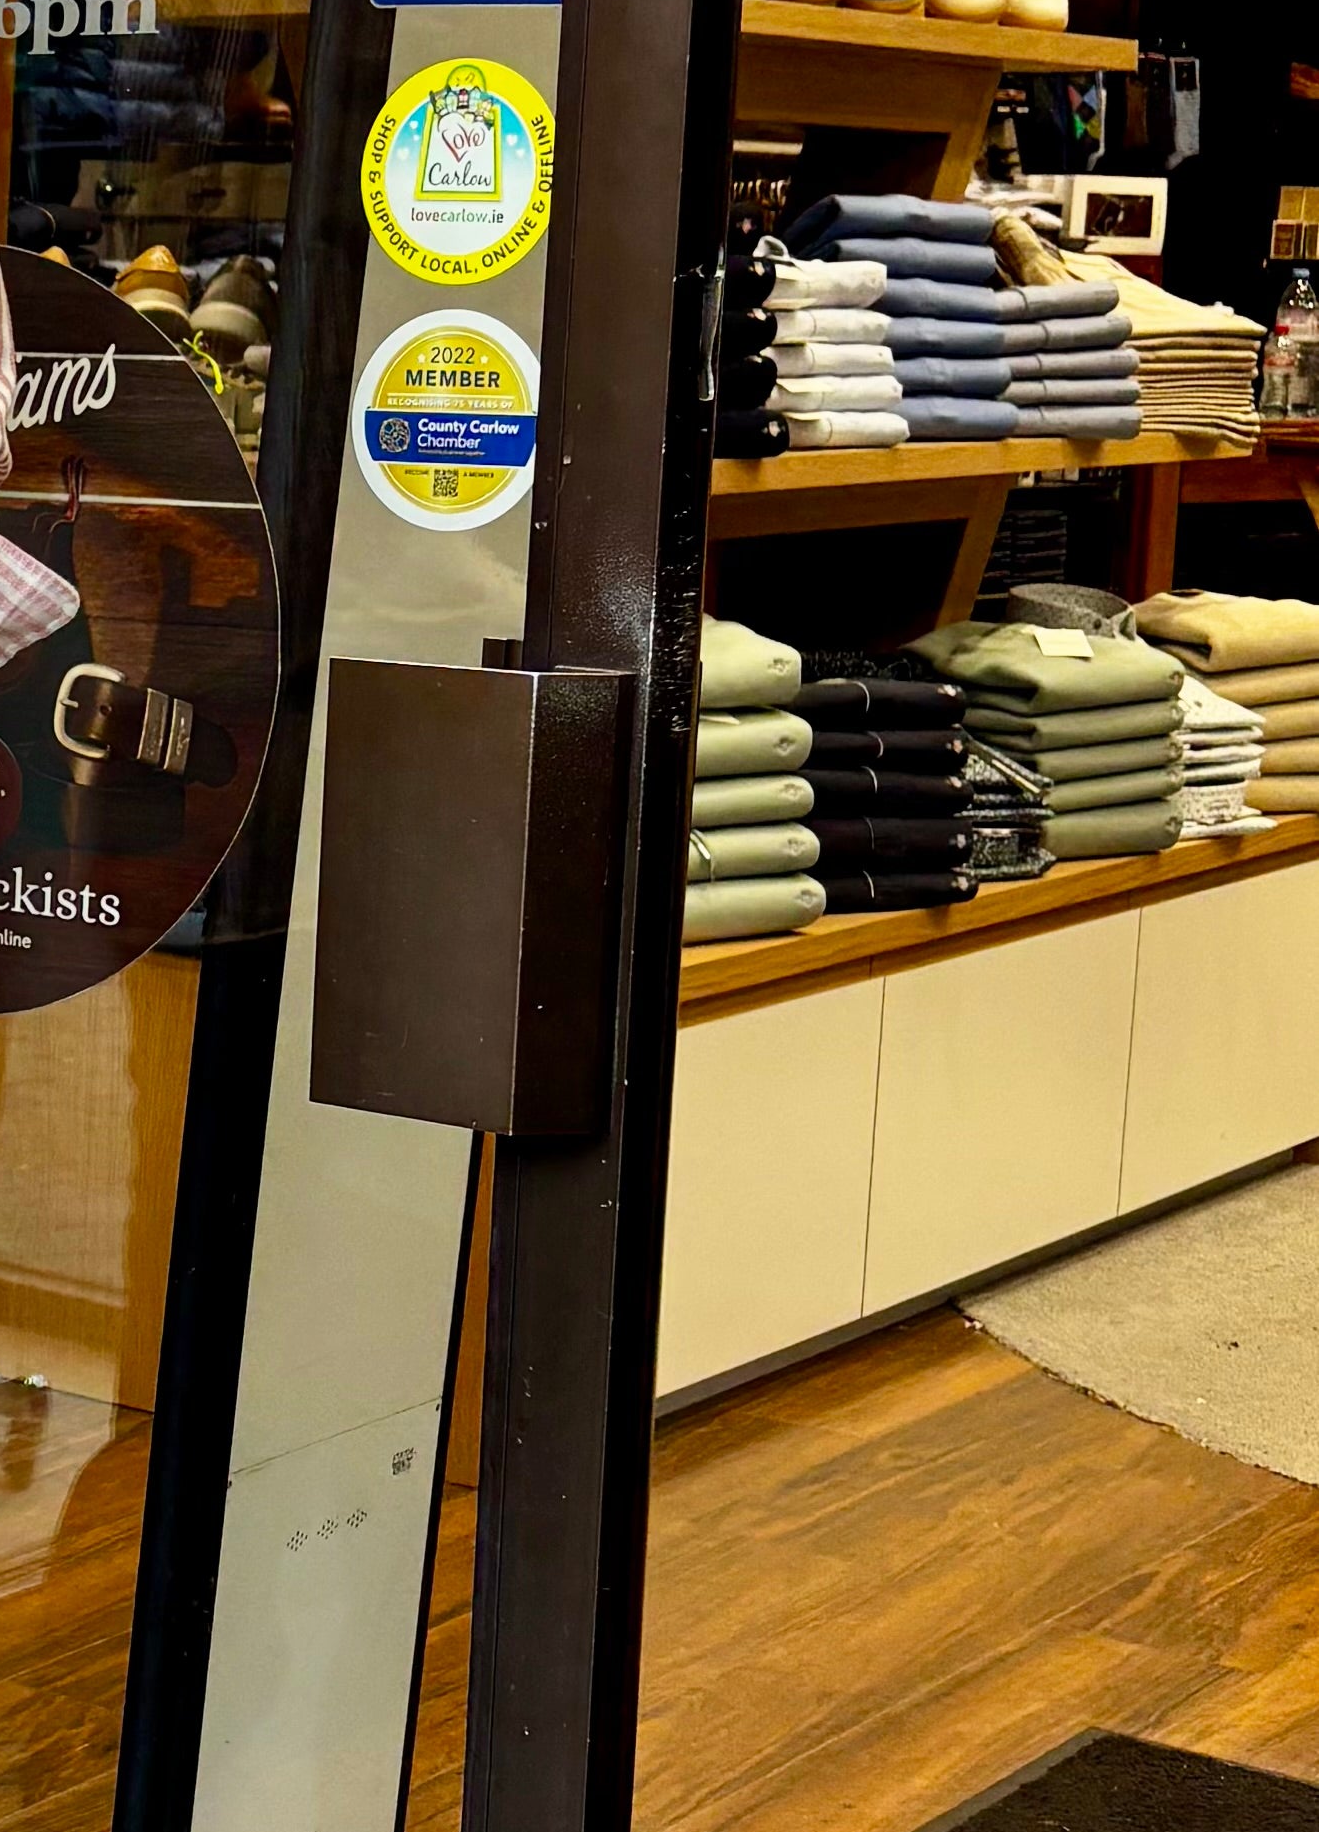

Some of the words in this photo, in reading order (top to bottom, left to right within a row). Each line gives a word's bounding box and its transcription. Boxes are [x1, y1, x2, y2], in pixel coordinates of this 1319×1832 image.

[374, 114, 397, 164] SHOP
[441, 125, 486, 163] Love
[532, 114, 554, 193] OFFLINE
[428, 160, 492, 187] Carlow
[370, 190, 419, 261] SUPPORT
[411, 208, 504, 224] lovecarlow.ie
[481, 216, 537, 268] ONLINE
[420, 253, 478, 274] LOCAL,
[430, 347, 476, 364] 2022
[406, 369, 500, 388] MEMBER
[467, 398, 499, 409] YEARS
[417, 418, 467, 437] County
[469, 419, 520, 435] Carlow
[417, 433, 481, 449] Chamber
